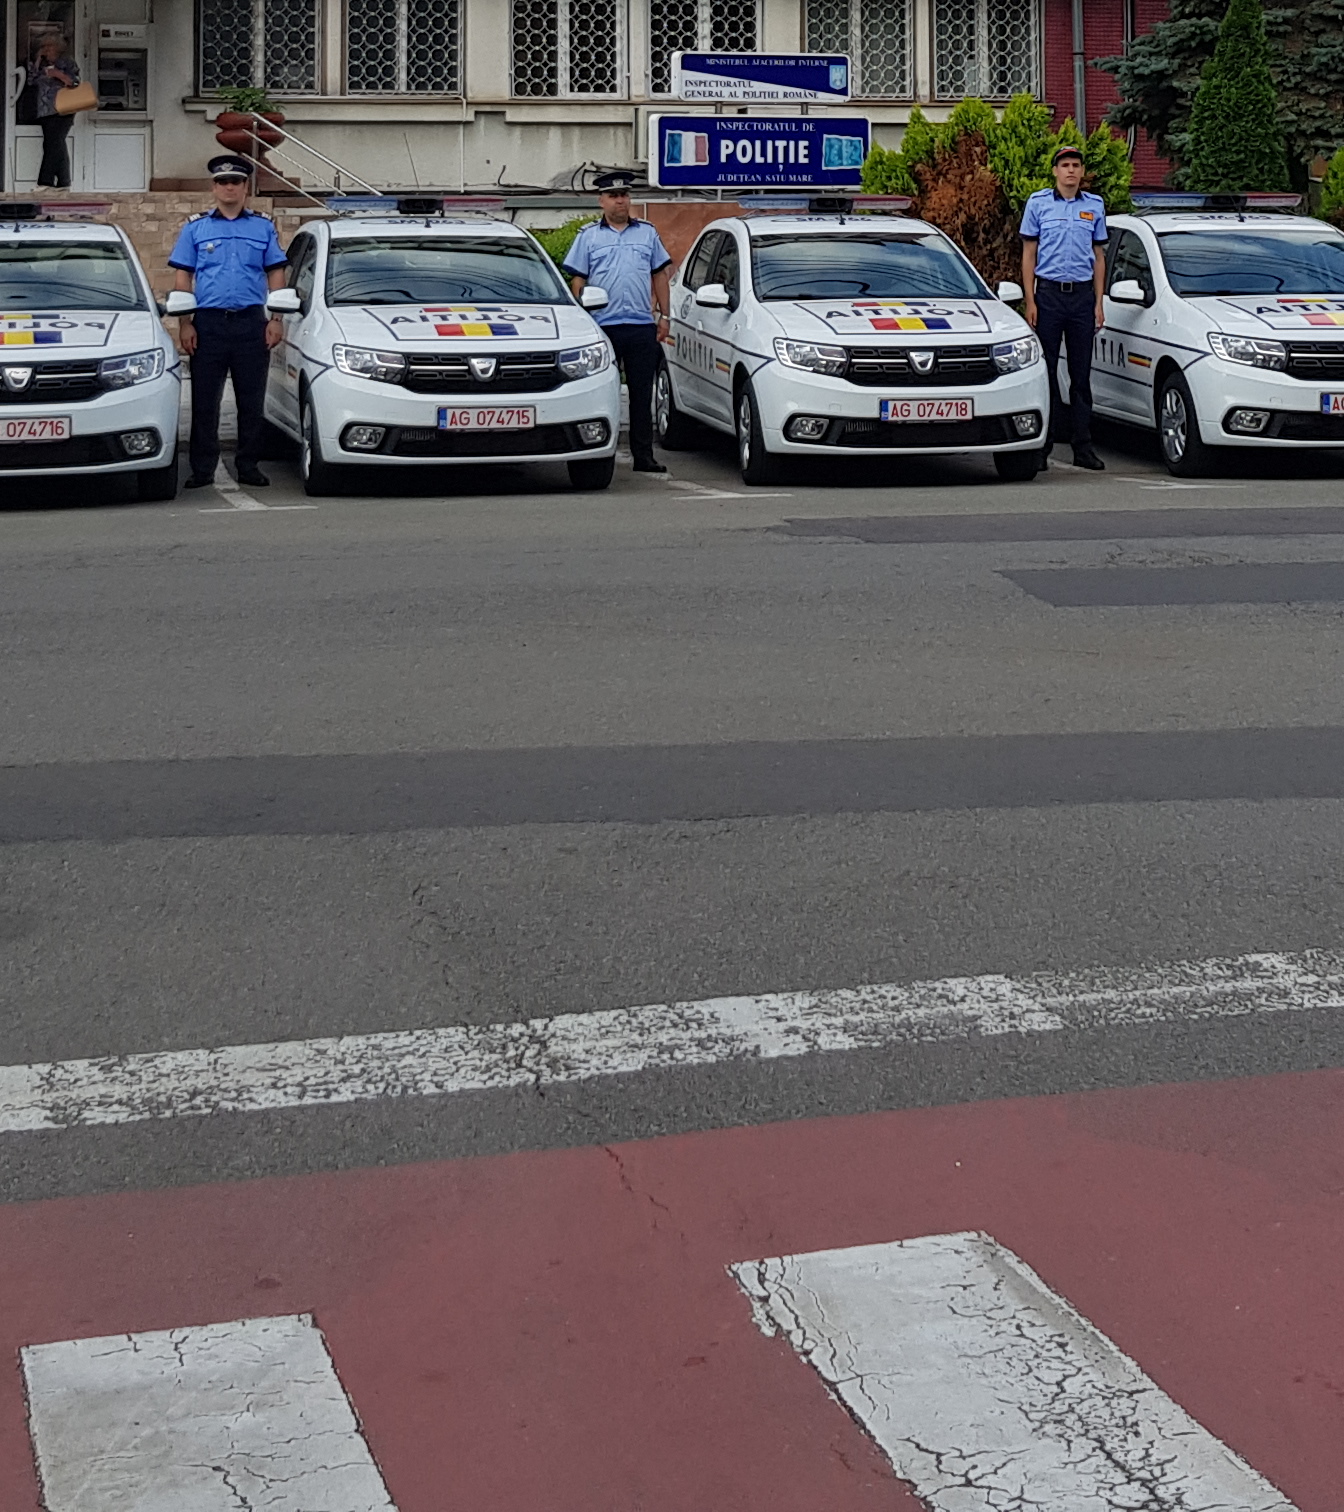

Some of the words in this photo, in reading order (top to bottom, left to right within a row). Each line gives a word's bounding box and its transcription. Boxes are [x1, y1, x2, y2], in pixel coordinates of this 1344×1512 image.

[684, 79, 754, 88] INSPECTORATUL
[684, 90, 725, 98] GENERAL
[783, 89, 819, 99] ROMÂNE
[716, 121, 799, 131] INSPECTORATUL
[802, 122, 816, 132] DE
[720, 139, 810, 172] POLIȚIE
[765, 174, 787, 182] SATU
[789, 174, 813, 182] MARE
[1094, 336, 1126, 368] ITIA
[449, 410, 470, 426] AG
[477, 409, 530, 426] 074715
[891, 402, 911, 418] AG
[917, 401, 968, 417] 074718
[6, 420, 65, 438] 074716
